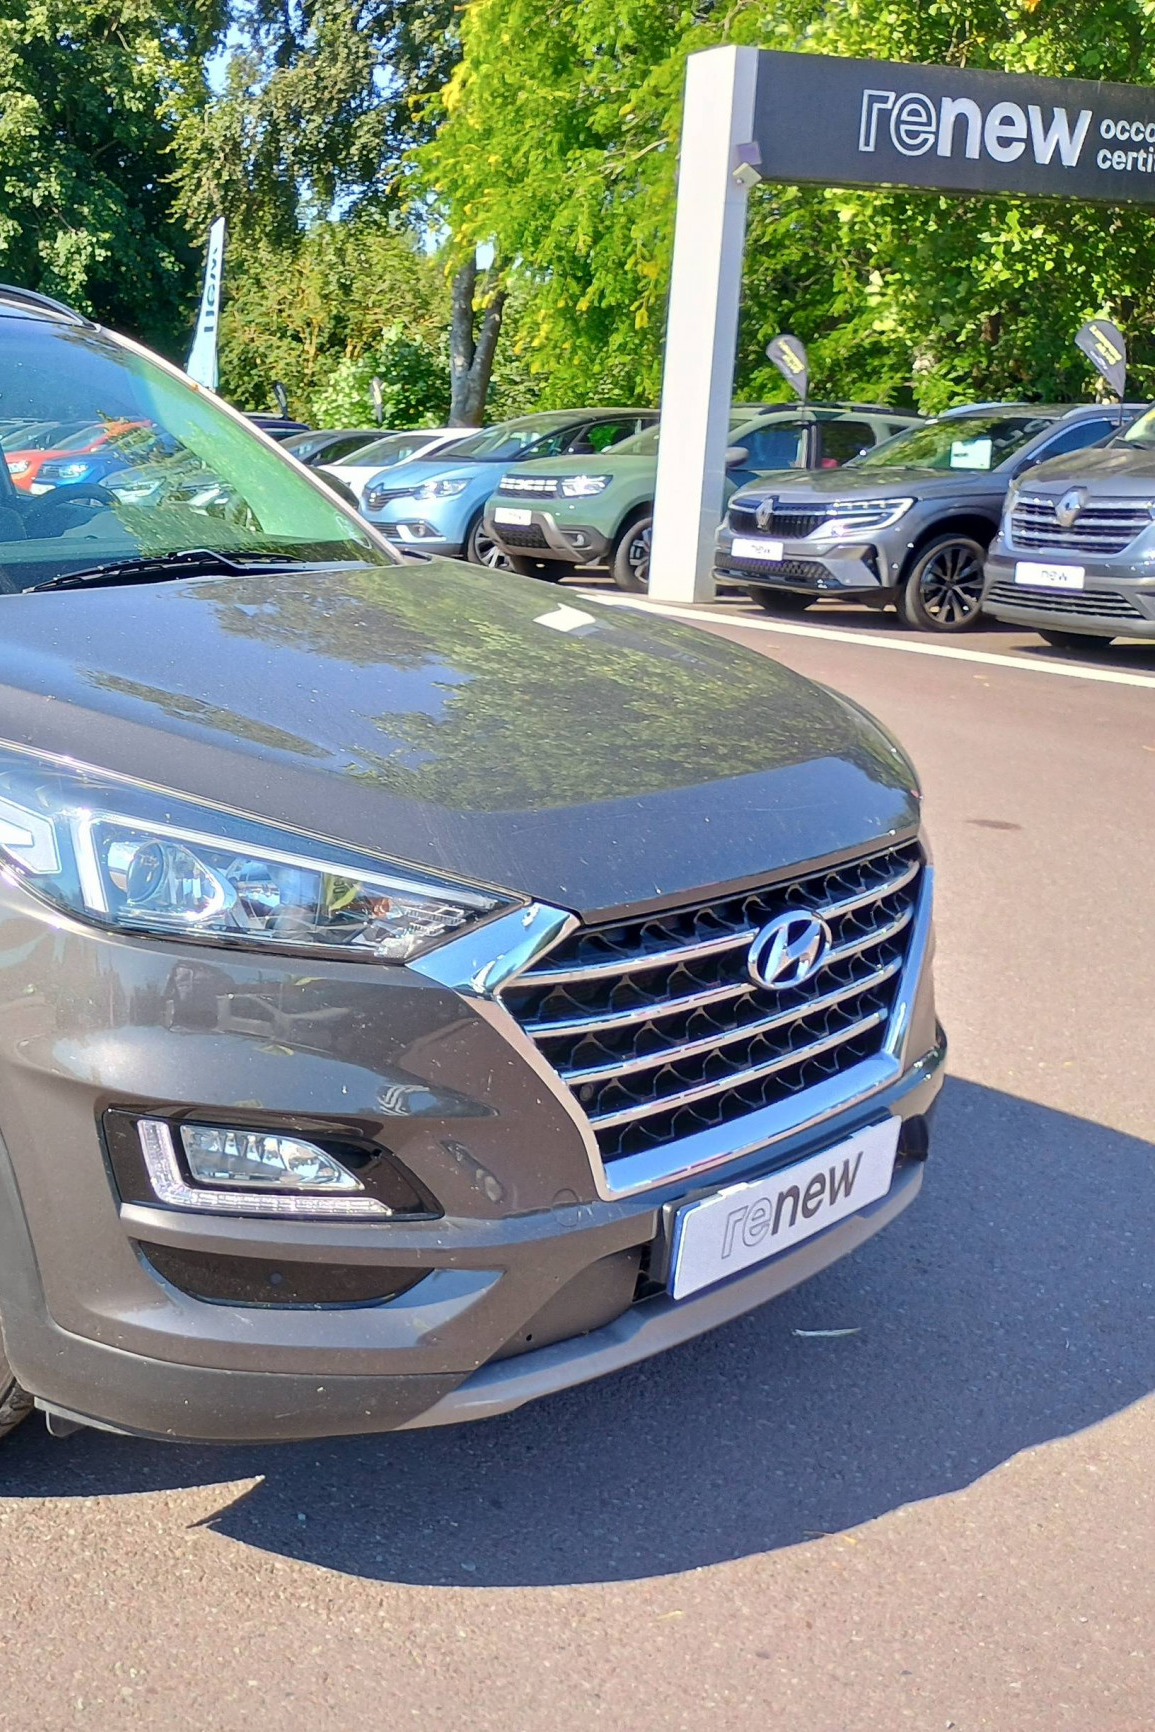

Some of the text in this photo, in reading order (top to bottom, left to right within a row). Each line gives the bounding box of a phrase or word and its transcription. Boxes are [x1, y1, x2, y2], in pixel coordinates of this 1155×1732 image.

[858, 88, 1093, 168] renew
[1096, 146, 1155, 173] certi
[721, 1151, 864, 1260] renew
